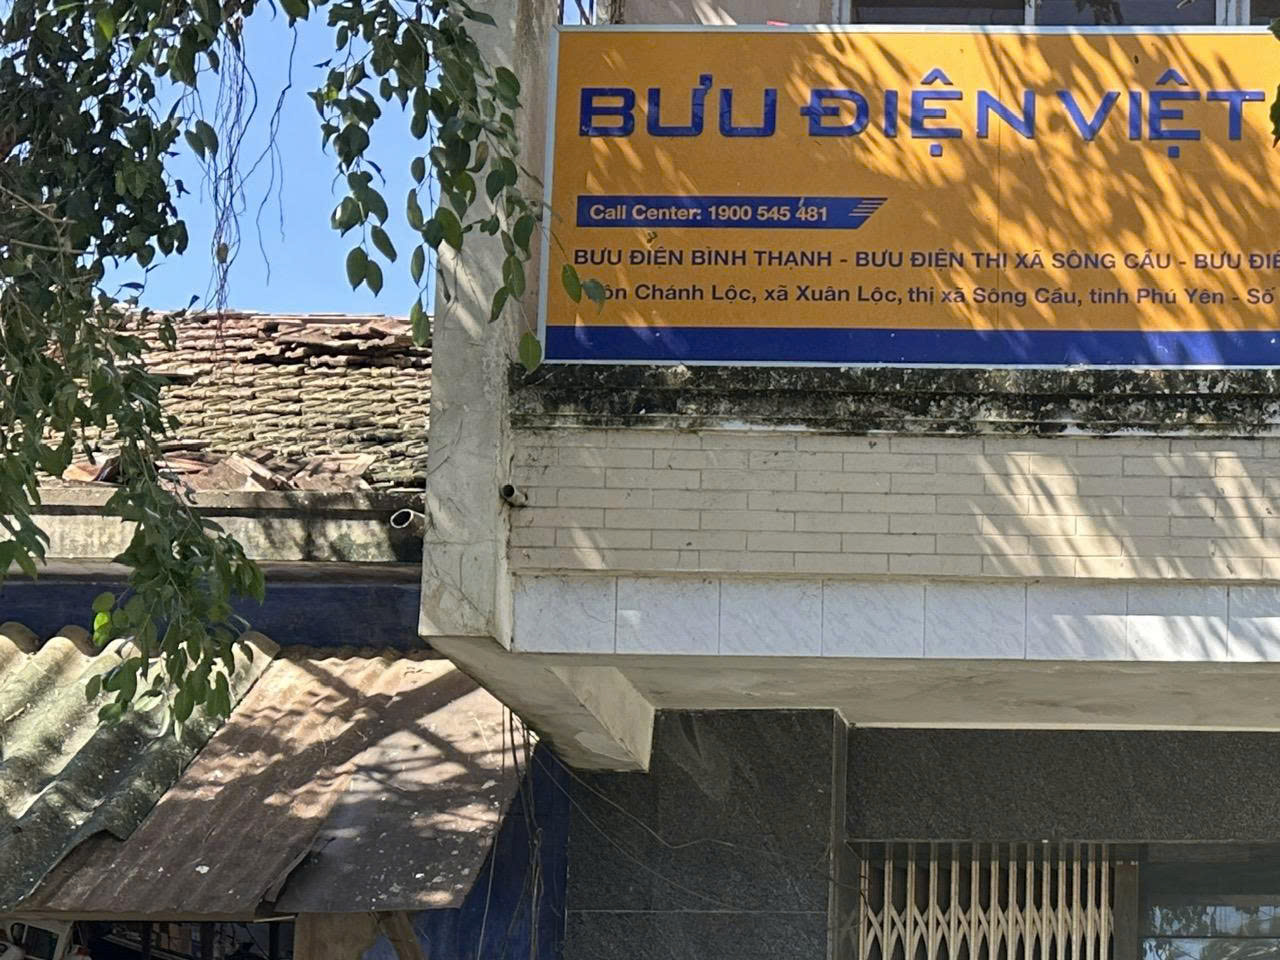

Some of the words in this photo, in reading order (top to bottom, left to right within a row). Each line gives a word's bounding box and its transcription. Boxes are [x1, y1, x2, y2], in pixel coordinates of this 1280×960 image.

[578, 74, 778, 137] BƯU
[799, 67, 1037, 157] ĐIỆN
[1056, 68, 1266, 158] VIỆT
[589, 204, 627, 220] Call
[632, 204, 702, 221] Center:
[708, 205, 752, 221] 1900
[757, 206, 790, 221] 545
[796, 206, 828, 221] 481
[574, 247, 622, 265] BƯU
[629, 246, 684, 269] ĐIỆN
[691, 246, 746, 266] BÌNH
[754, 250, 832, 270] THẠNH
[855, 250, 903, 267] BƯU
[910, 248, 964, 271] ĐIỆN
[971, 252, 1008, 272] THỊ
[1015, 250, 1044, 269] XÃ
[1052, 248, 1116, 269] SÔNG
[1194, 252, 1241, 269] BƯU
[634, 284, 704, 300] Chánh
[711, 284, 757, 304] Lộc,
[764, 286, 789, 301] xã
[796, 285, 850, 302] Xuân
[858, 286, 902, 306] Lộc,
[907, 287, 934, 305] thị
[941, 289, 966, 304] xã
[973, 287, 1027, 306] Sông
[1136, 288, 1177, 304] Phú
[1184, 288, 1224, 304] Yên
[1247, 286, 1276, 305] Số
